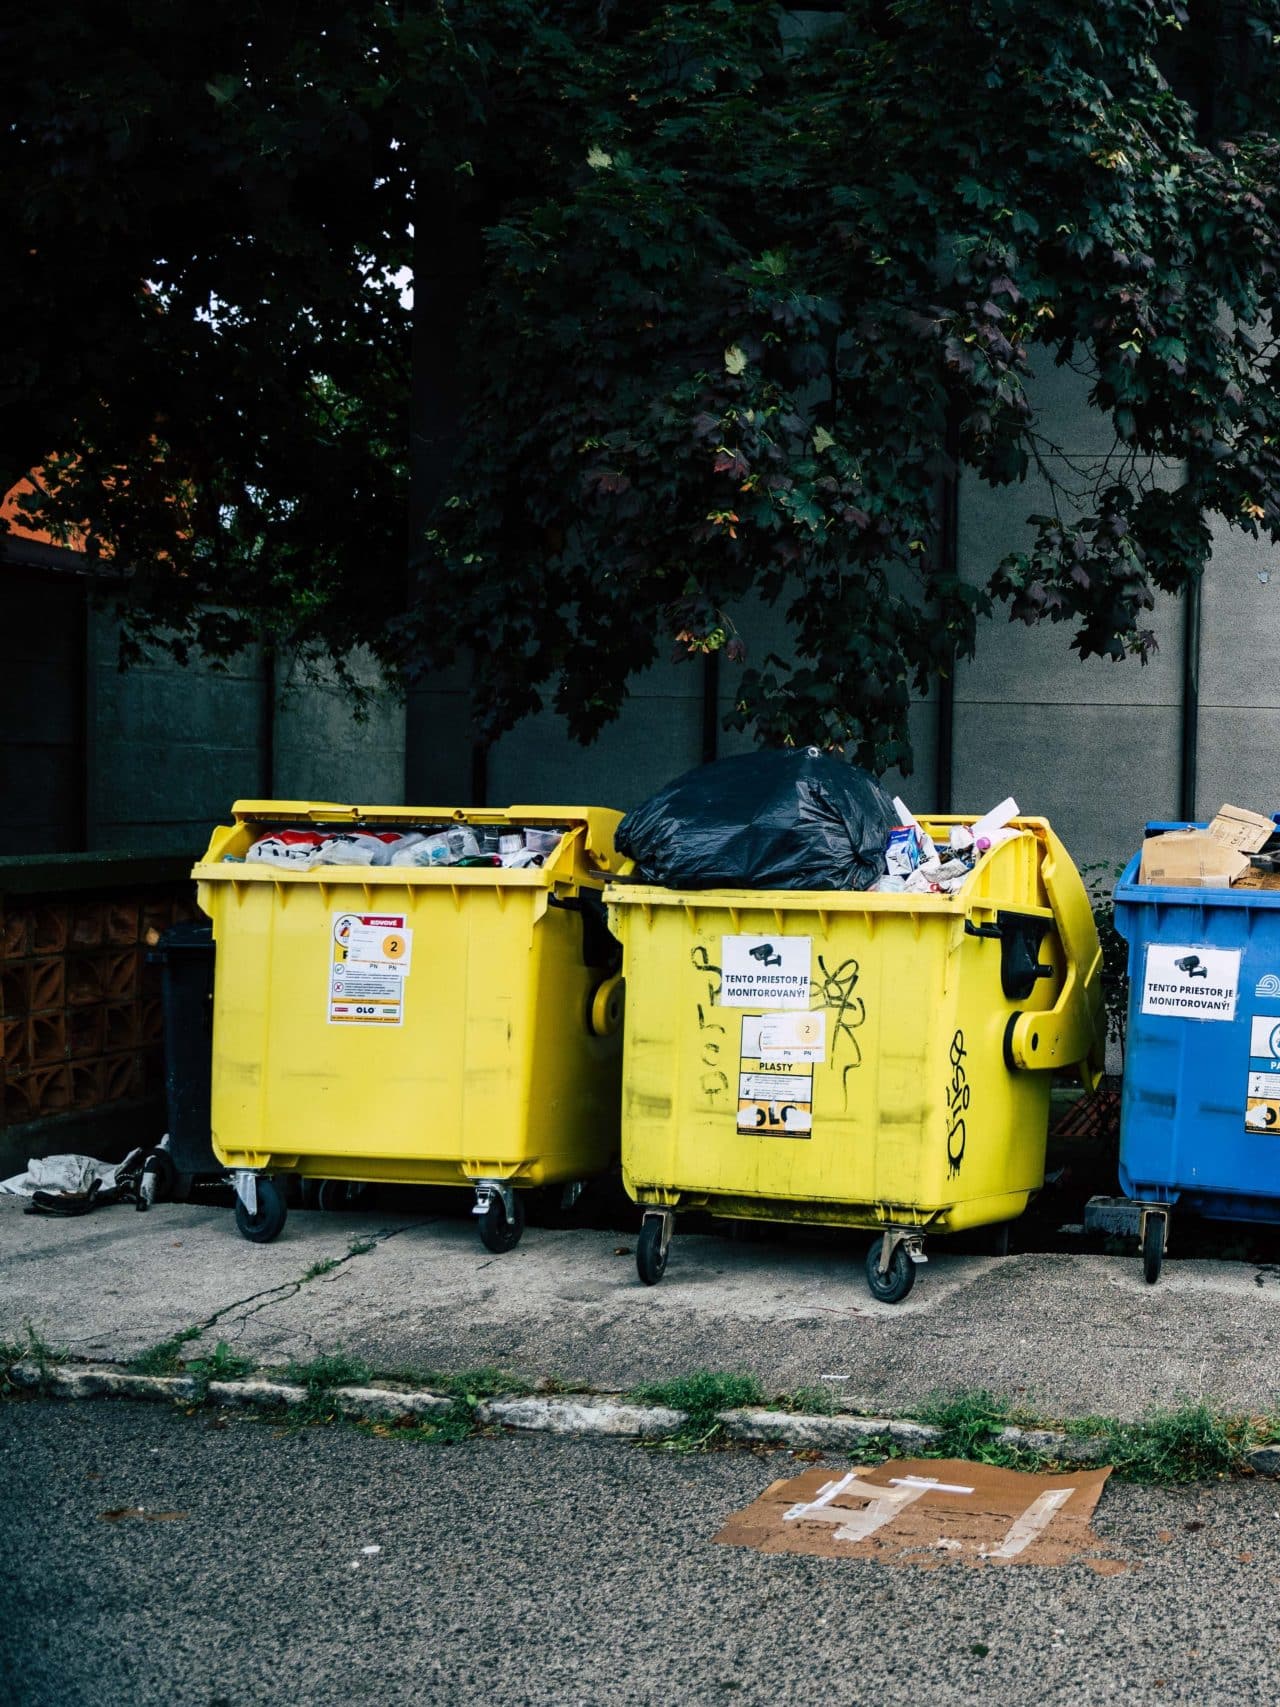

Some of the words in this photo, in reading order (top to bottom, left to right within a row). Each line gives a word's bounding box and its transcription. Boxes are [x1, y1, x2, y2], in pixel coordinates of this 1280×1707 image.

[390, 941, 398, 952] 2
[725, 975, 754, 983] TENTO
[756, 975, 798, 984] PRIESTOR
[799, 976, 809, 986] JE
[727, 987, 805, 998] MONITOROVANÝ!
[1148, 983, 1177, 993] TENTO
[1179, 985, 1223, 997] PRIESTOR
[1224, 988, 1234, 999] JE
[1149, 996, 1230, 1011] MONITOROVANÝ!
[356, 1006, 375, 1014] OLO
[804, 1025, 810, 1034] 2
[759, 1062, 793, 1071] PLASTY
